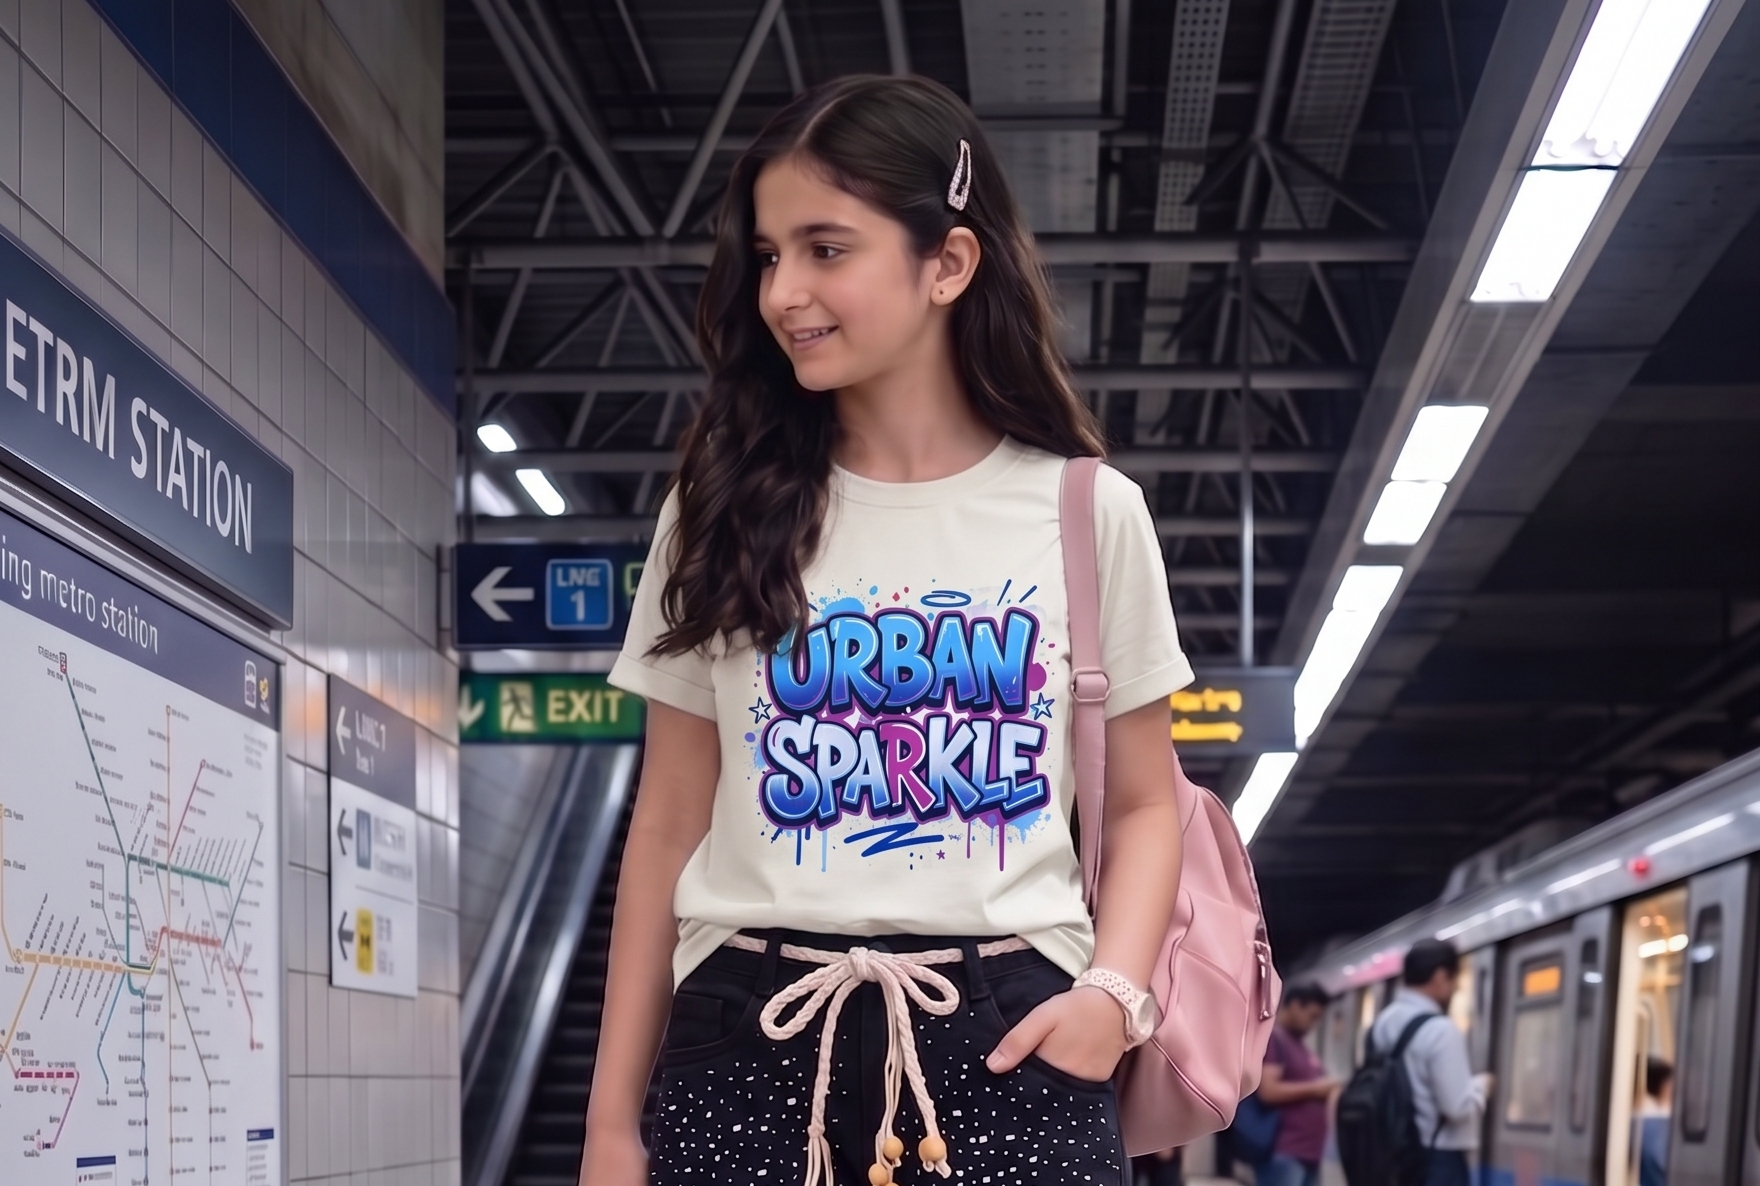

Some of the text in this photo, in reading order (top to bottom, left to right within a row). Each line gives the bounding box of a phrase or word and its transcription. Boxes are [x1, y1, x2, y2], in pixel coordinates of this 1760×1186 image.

[5, 298, 253, 554] ETRM STATION
[1, 534, 158, 655] ing metro station
[570, 589, 586, 622] 1
[547, 689, 624, 723] EXIT
[766, 608, 1036, 714] URBAN
[762, 713, 1048, 824] SPARKLE
